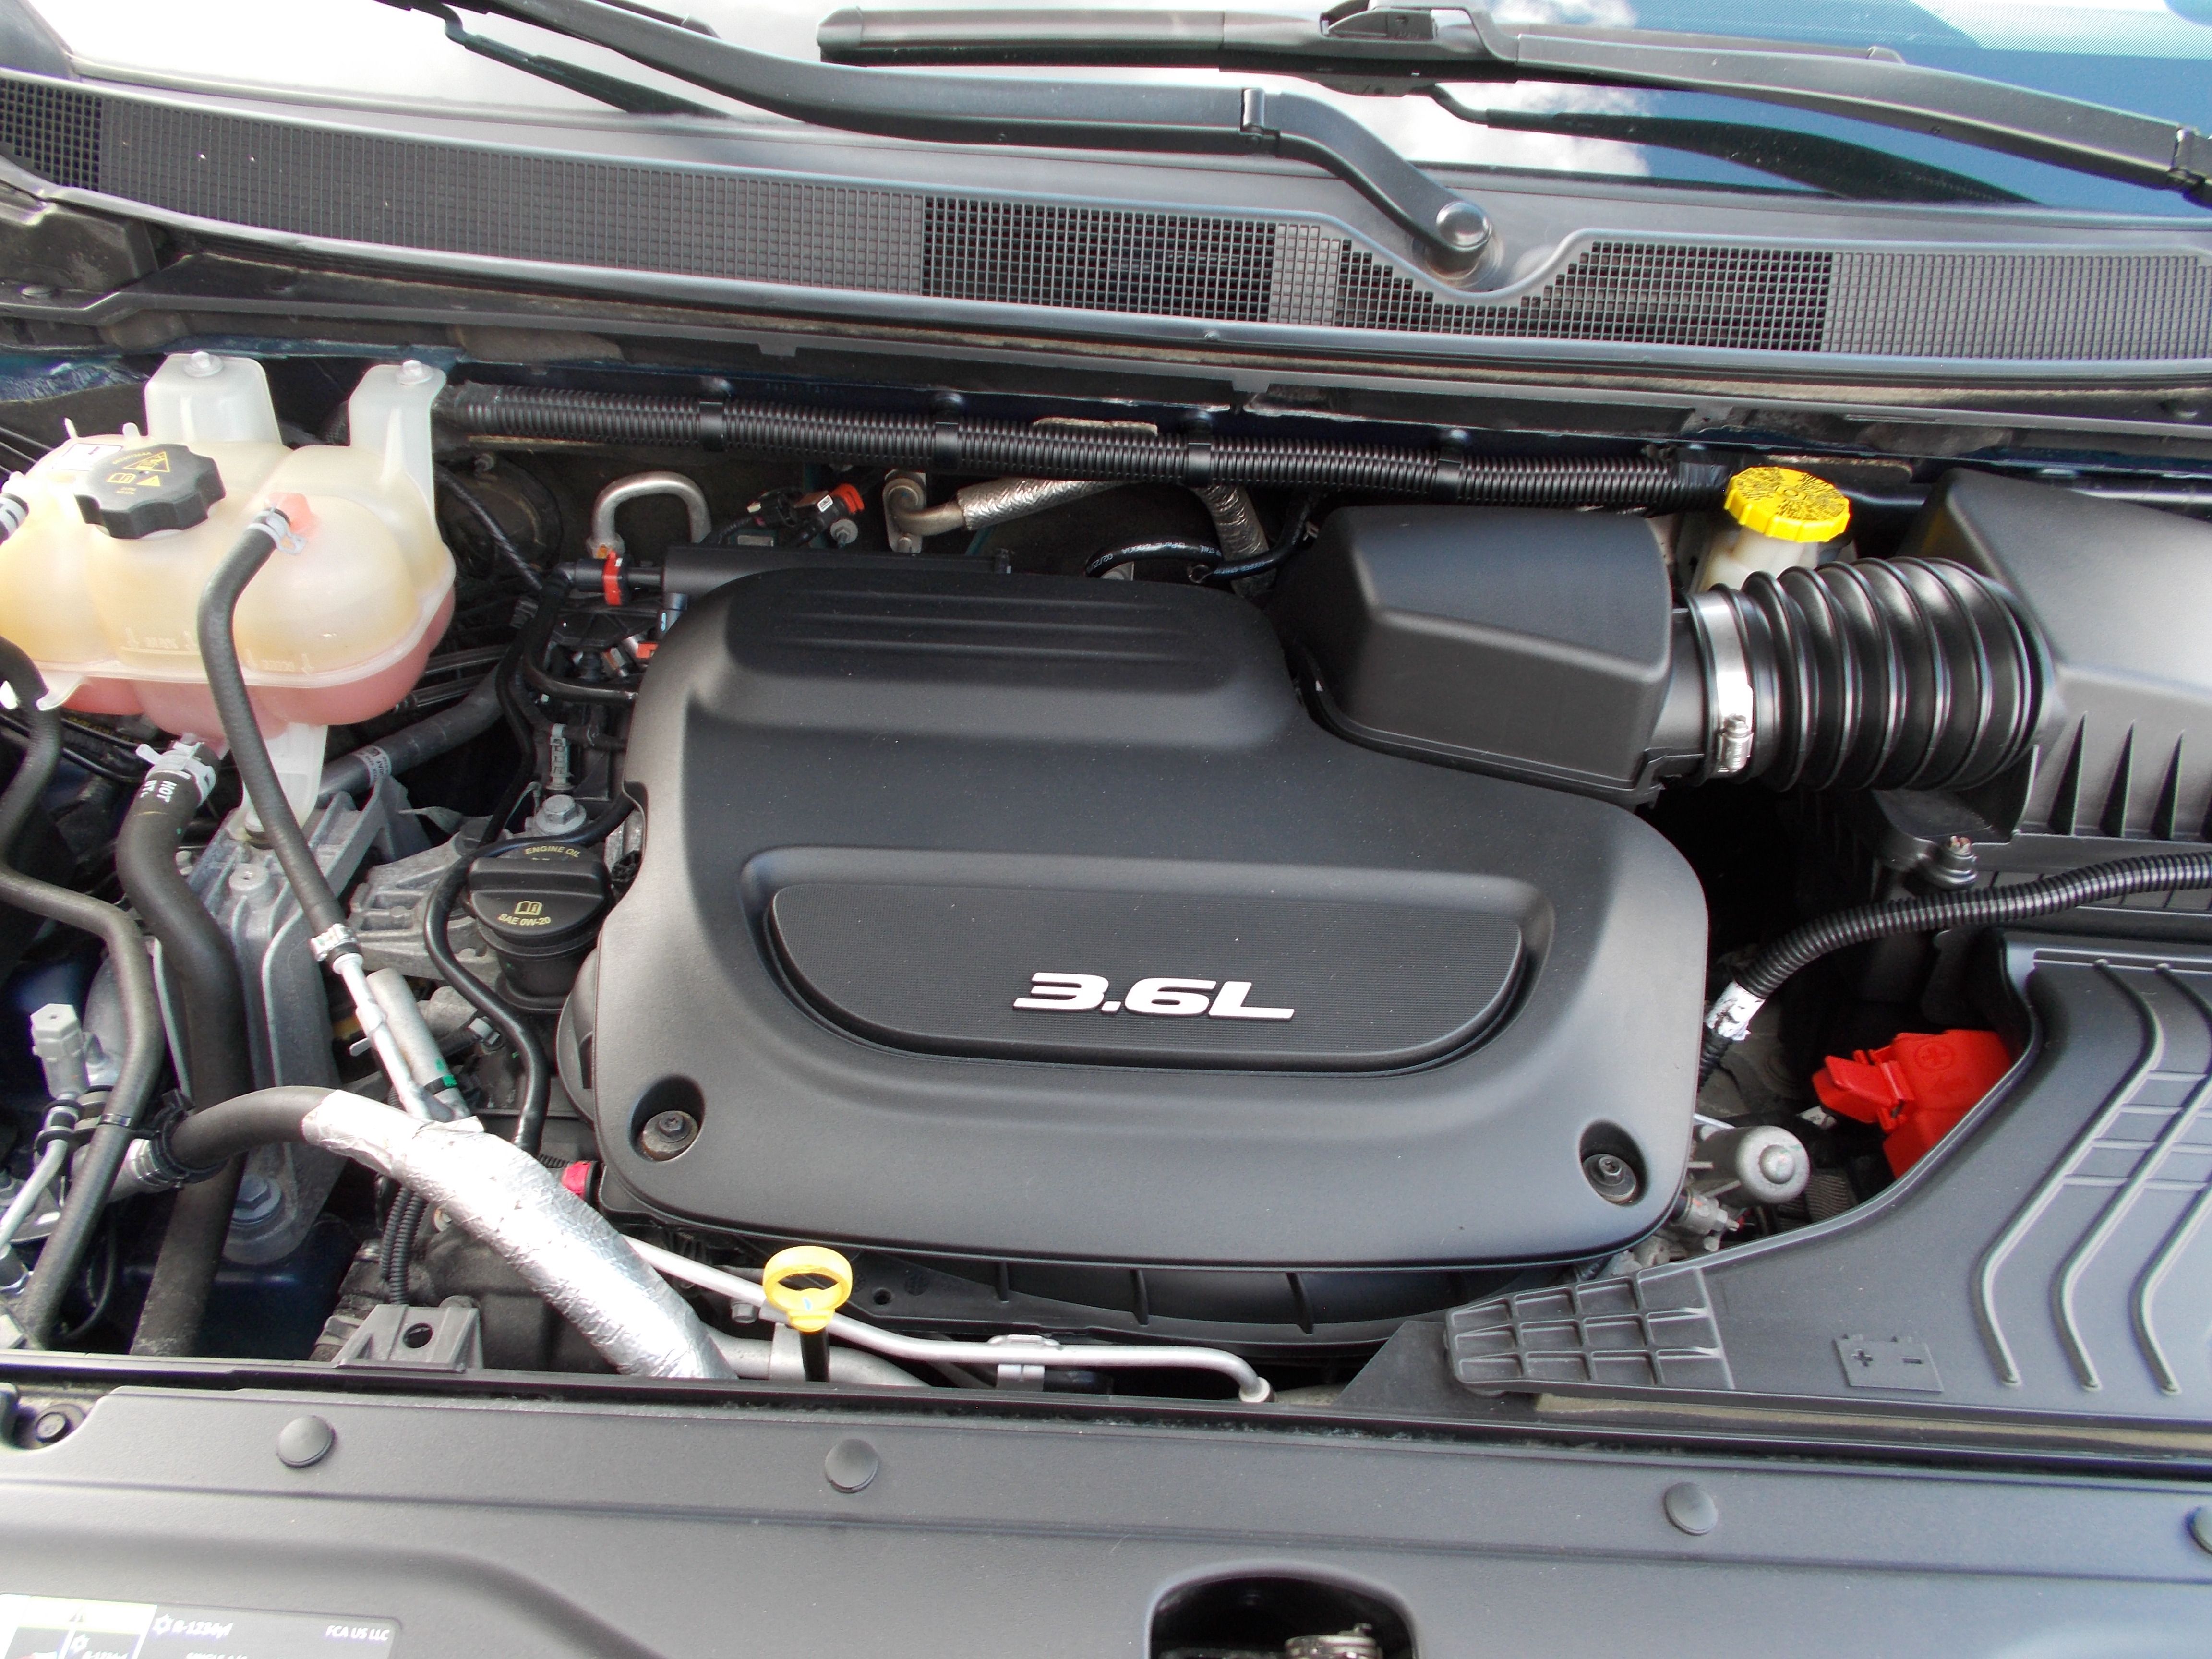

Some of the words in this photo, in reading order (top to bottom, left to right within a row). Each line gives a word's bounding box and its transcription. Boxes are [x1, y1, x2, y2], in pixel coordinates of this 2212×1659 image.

[156, 780, 177, 803] HOT
[525, 846, 565, 854] ENGINE
[565, 848, 581, 858] OIL
[498, 913, 520, 925] SAE
[519, 916, 551, 926] 0W-20
[1013, 972, 1295, 1021] 3.6L
[326, 1625, 349, 1637] FCA
[350, 1627, 369, 1639] US
[368, 1628, 390, 1641] LLC
